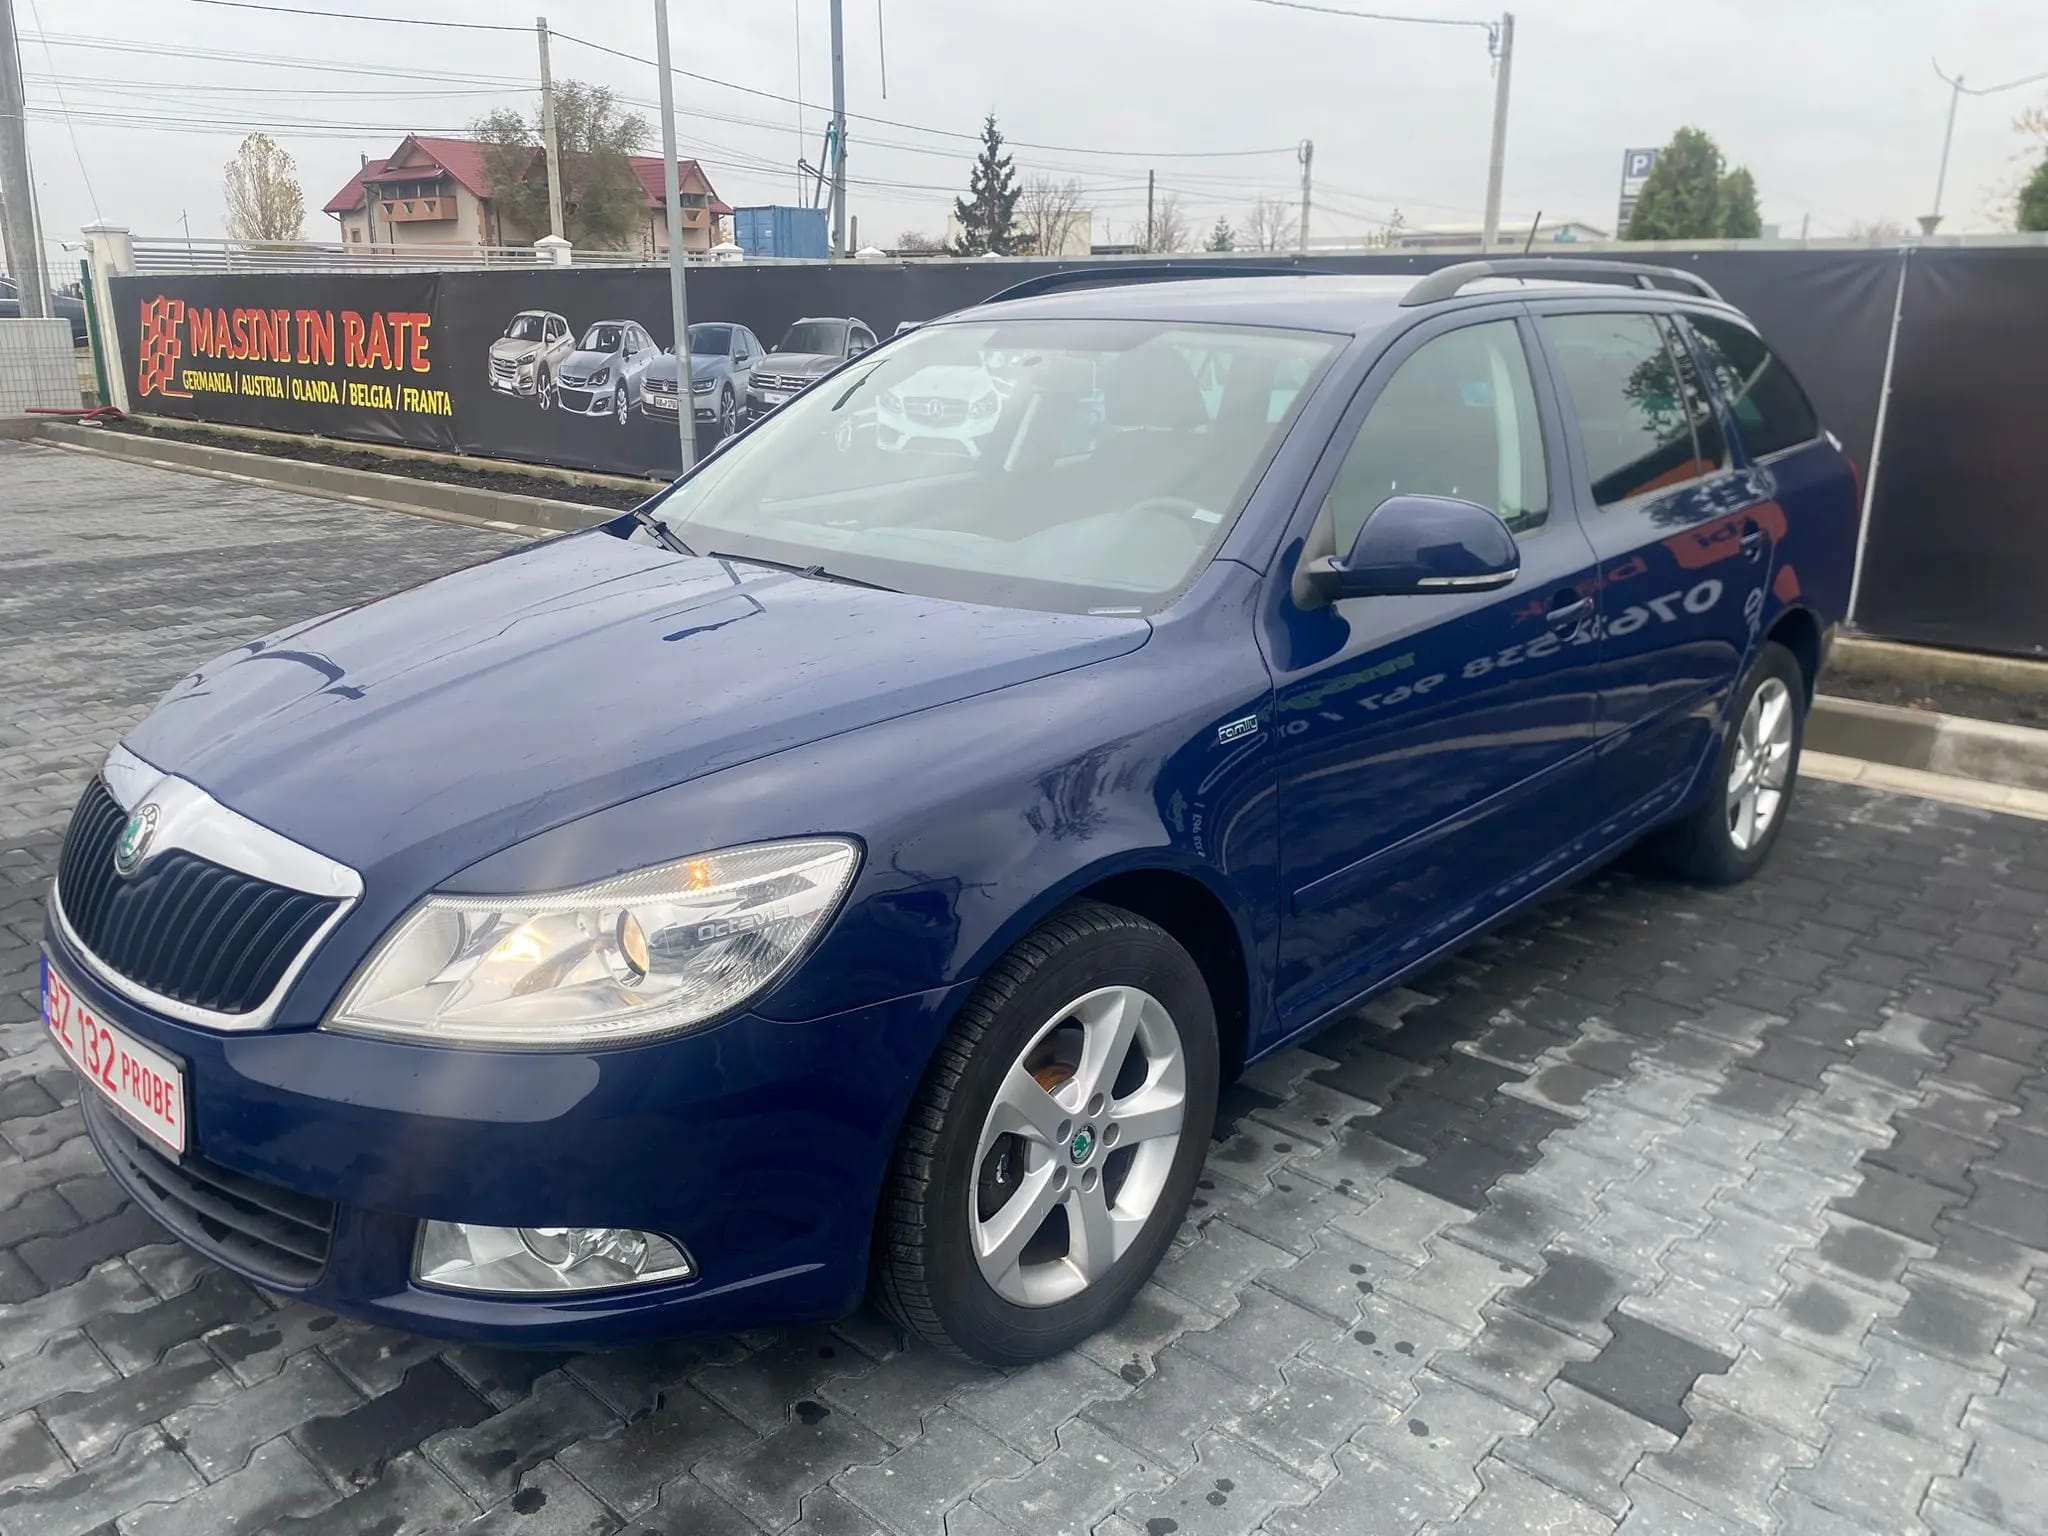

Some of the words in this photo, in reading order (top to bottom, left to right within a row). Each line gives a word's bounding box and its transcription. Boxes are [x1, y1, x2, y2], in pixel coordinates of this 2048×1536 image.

[188, 308, 291, 362] MASINI
[296, 309, 334, 366] IN
[341, 311, 431, 372] RATE
[183, 370, 233, 394] GERMANIA
[241, 375, 284, 398] AUSTRIA
[292, 379, 339, 404] OLANDA
[349, 383, 393, 409] BELGIA
[404, 388, 452, 416] FRANTA
[1218, 717, 1258, 742] Family
[48, 970, 73, 1049] BZ
[78, 1007, 117, 1092] 132
[122, 1051, 174, 1124] PROBE
